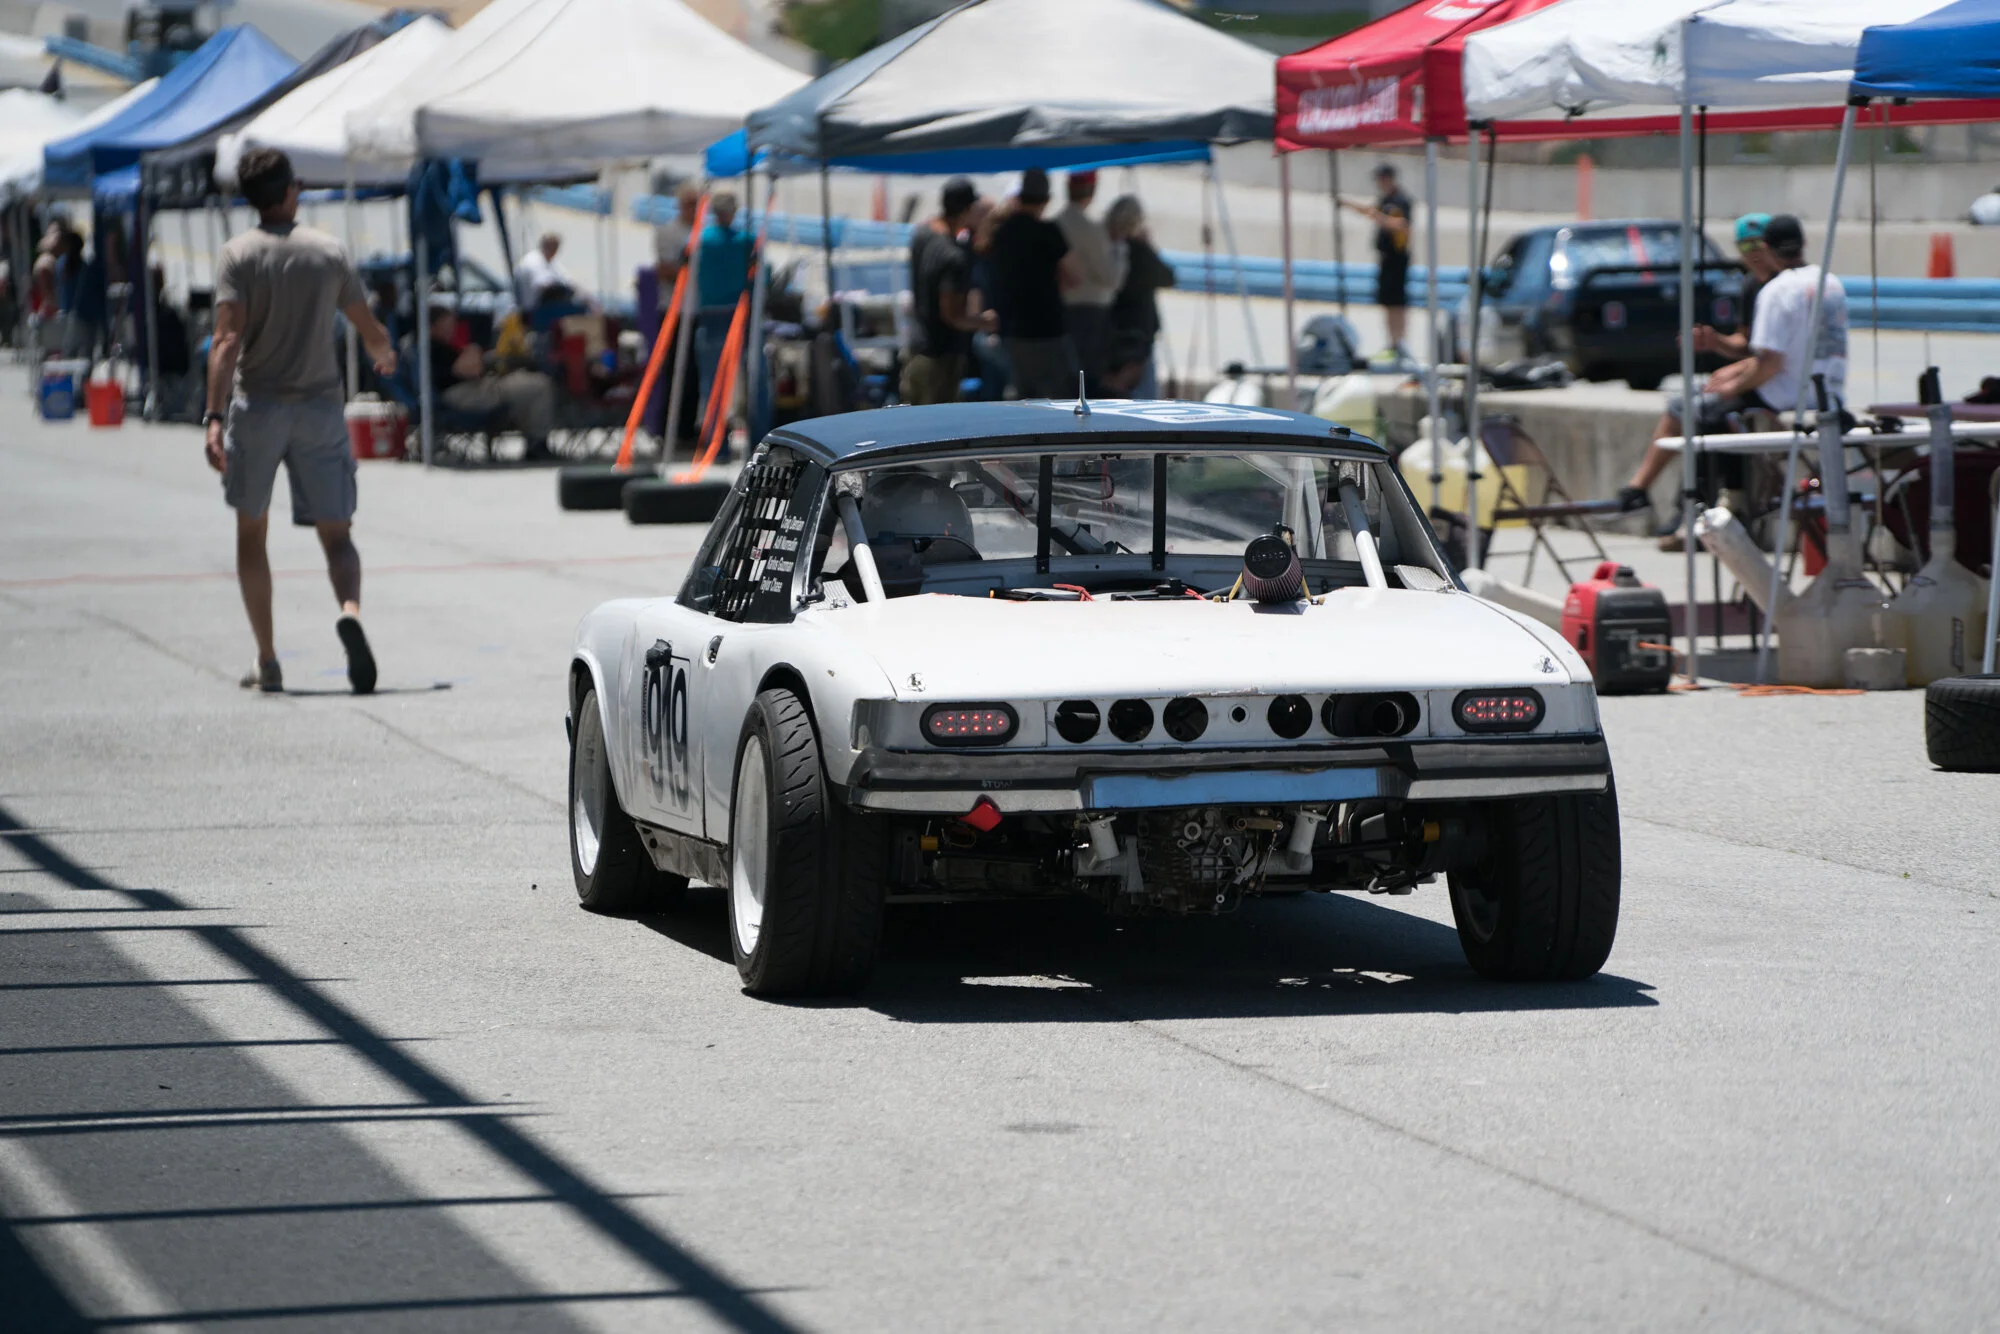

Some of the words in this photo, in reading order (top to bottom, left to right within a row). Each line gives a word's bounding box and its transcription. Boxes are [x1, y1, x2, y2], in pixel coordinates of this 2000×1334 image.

[780, 515, 792, 533] Craig
[759, 576, 773, 594] Taylor
[770, 577, 783, 593] Chase
[648, 663, 689, 813] 919
